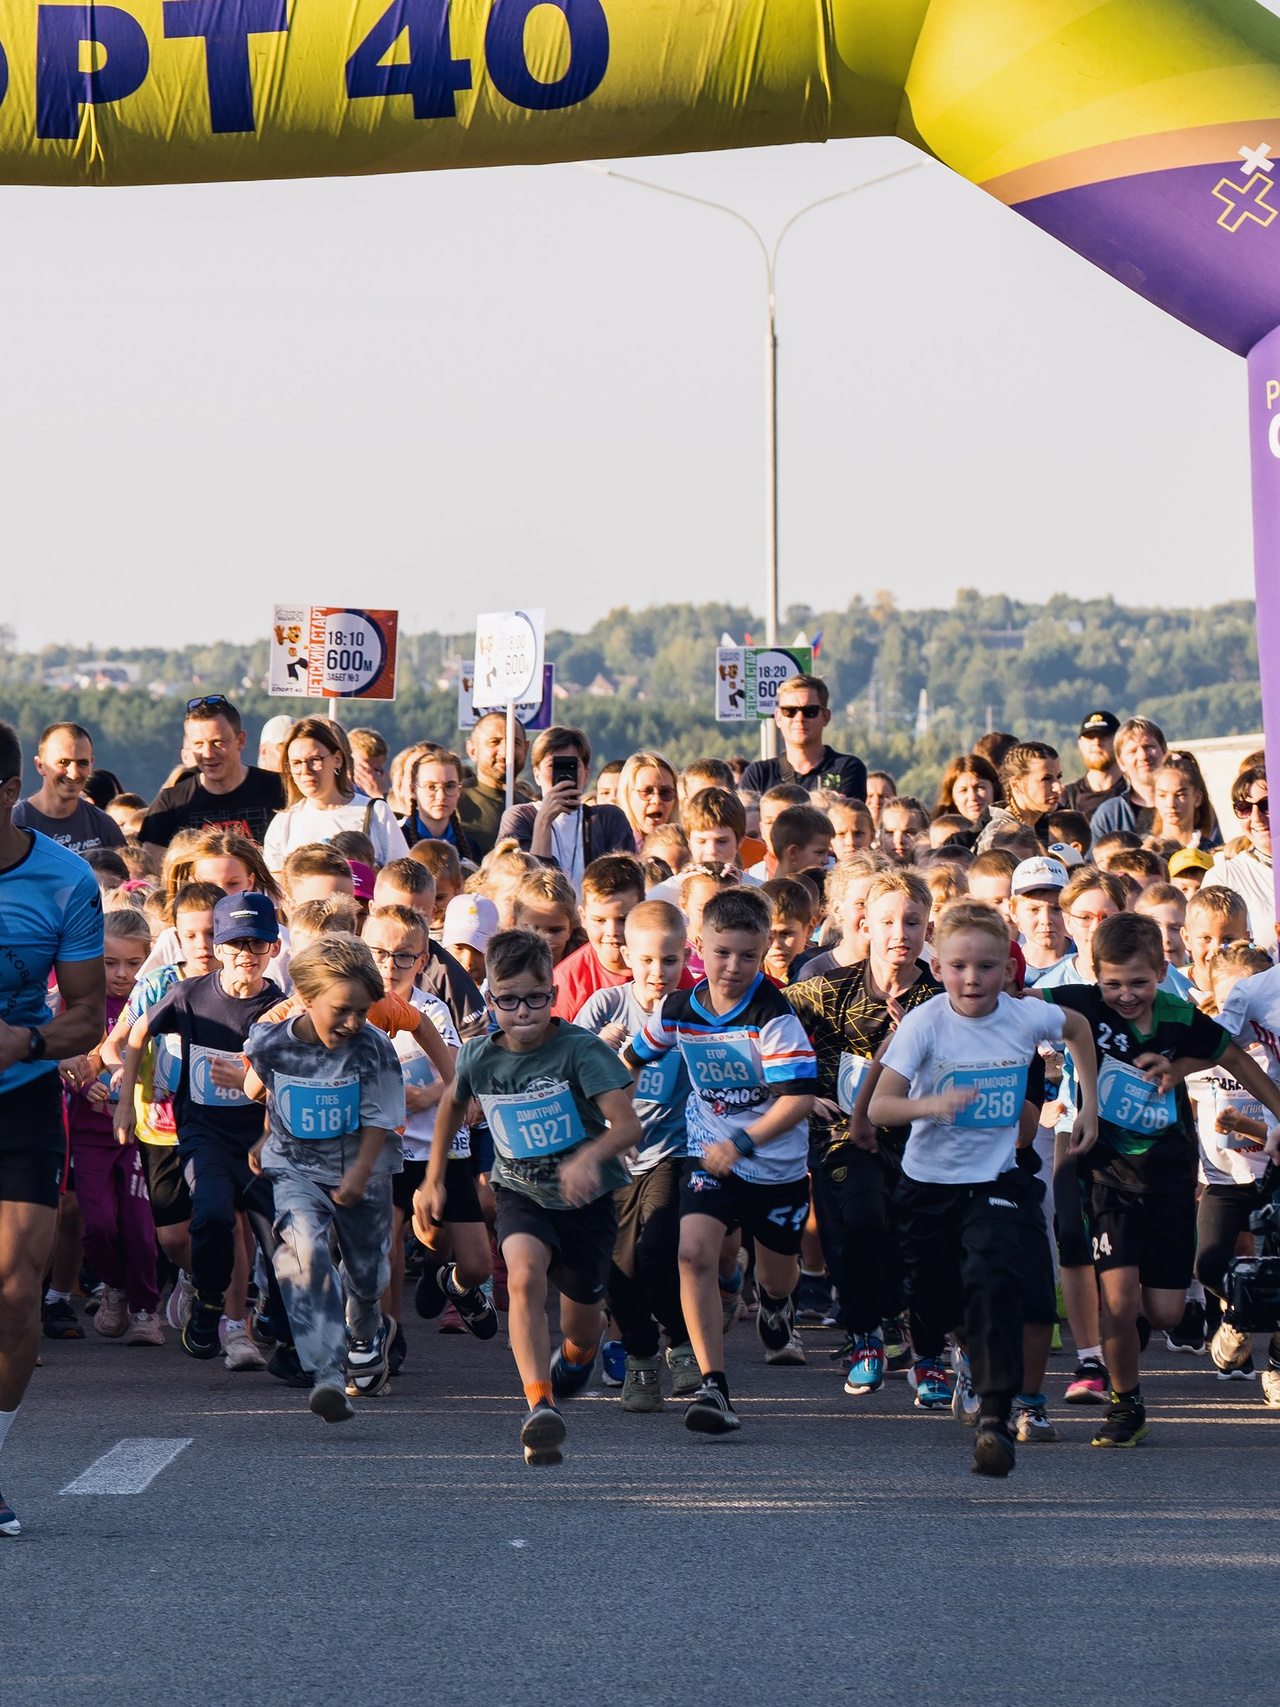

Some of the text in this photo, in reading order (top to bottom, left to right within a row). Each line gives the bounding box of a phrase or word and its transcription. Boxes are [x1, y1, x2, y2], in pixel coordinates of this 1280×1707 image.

[345, 0, 610, 120] 40
[328, 631, 364, 646] 18:10
[308, 643, 326, 696] ДЕТСКИЙ
[759, 666, 786, 677] 18:20
[759, 681, 784, 697] 60
[706, 1049, 727, 1059] ЕГОР
[696, 1061, 749, 1082] 2643
[973, 1073, 1017, 1089] ТИМОФЕЙ
[315, 1095, 339, 1105] ГЛЕБ
[302, 1105, 352, 1132] 5181
[516, 1102, 562, 1122] ДМИТРИЙ
[519, 1113, 572, 1149] 1927
[1092, 1232, 1112, 1261] 24
[859, 1349, 878, 1358] FILA
